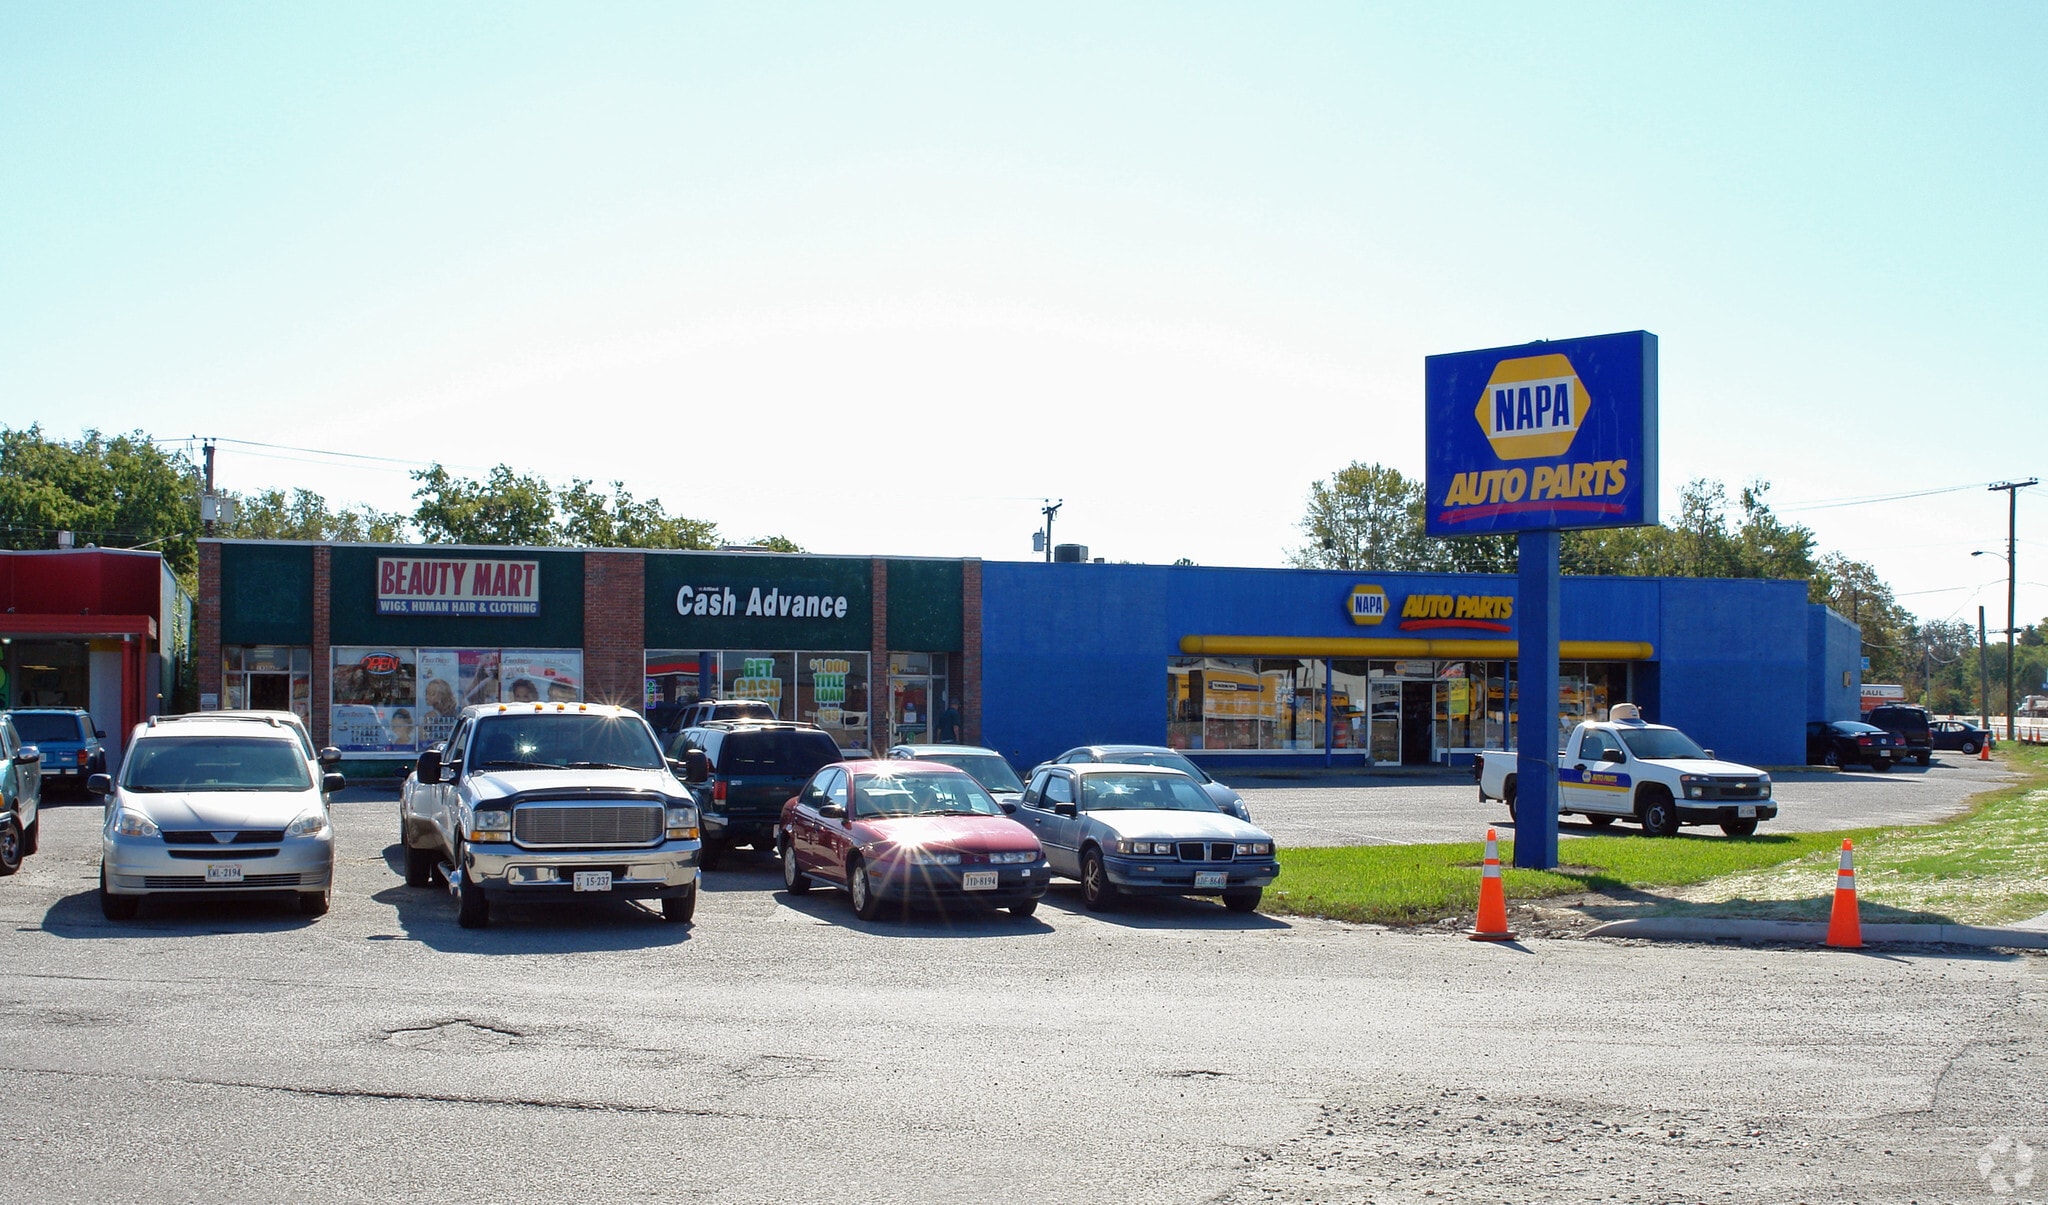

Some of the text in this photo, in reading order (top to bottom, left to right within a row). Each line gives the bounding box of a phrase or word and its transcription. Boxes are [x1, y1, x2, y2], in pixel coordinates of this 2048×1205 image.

[1495, 383, 1570, 432] NAPA
[1444, 459, 1627, 507] AUTO PARTS
[380, 561, 536, 597] BEAUTY MART
[380, 601, 537, 614] WIGS, HUMAN HAIR & CLOTHING
[676, 585, 848, 618] Cash Advance
[1355, 596, 1383, 614] NAPA
[1401, 594, 1514, 619] AUTO PARTS
[361, 657, 400, 671] OPEN
[744, 659, 774, 677] GET
[735, 679, 780, 698] CASH
[814, 674, 844, 688] TITLE
[647, 680, 655, 707] OPEN
[815, 689, 844, 702] LOAN
[1275, 694, 1295, 704] GAS
[586, 876, 610, 887] 15-237
